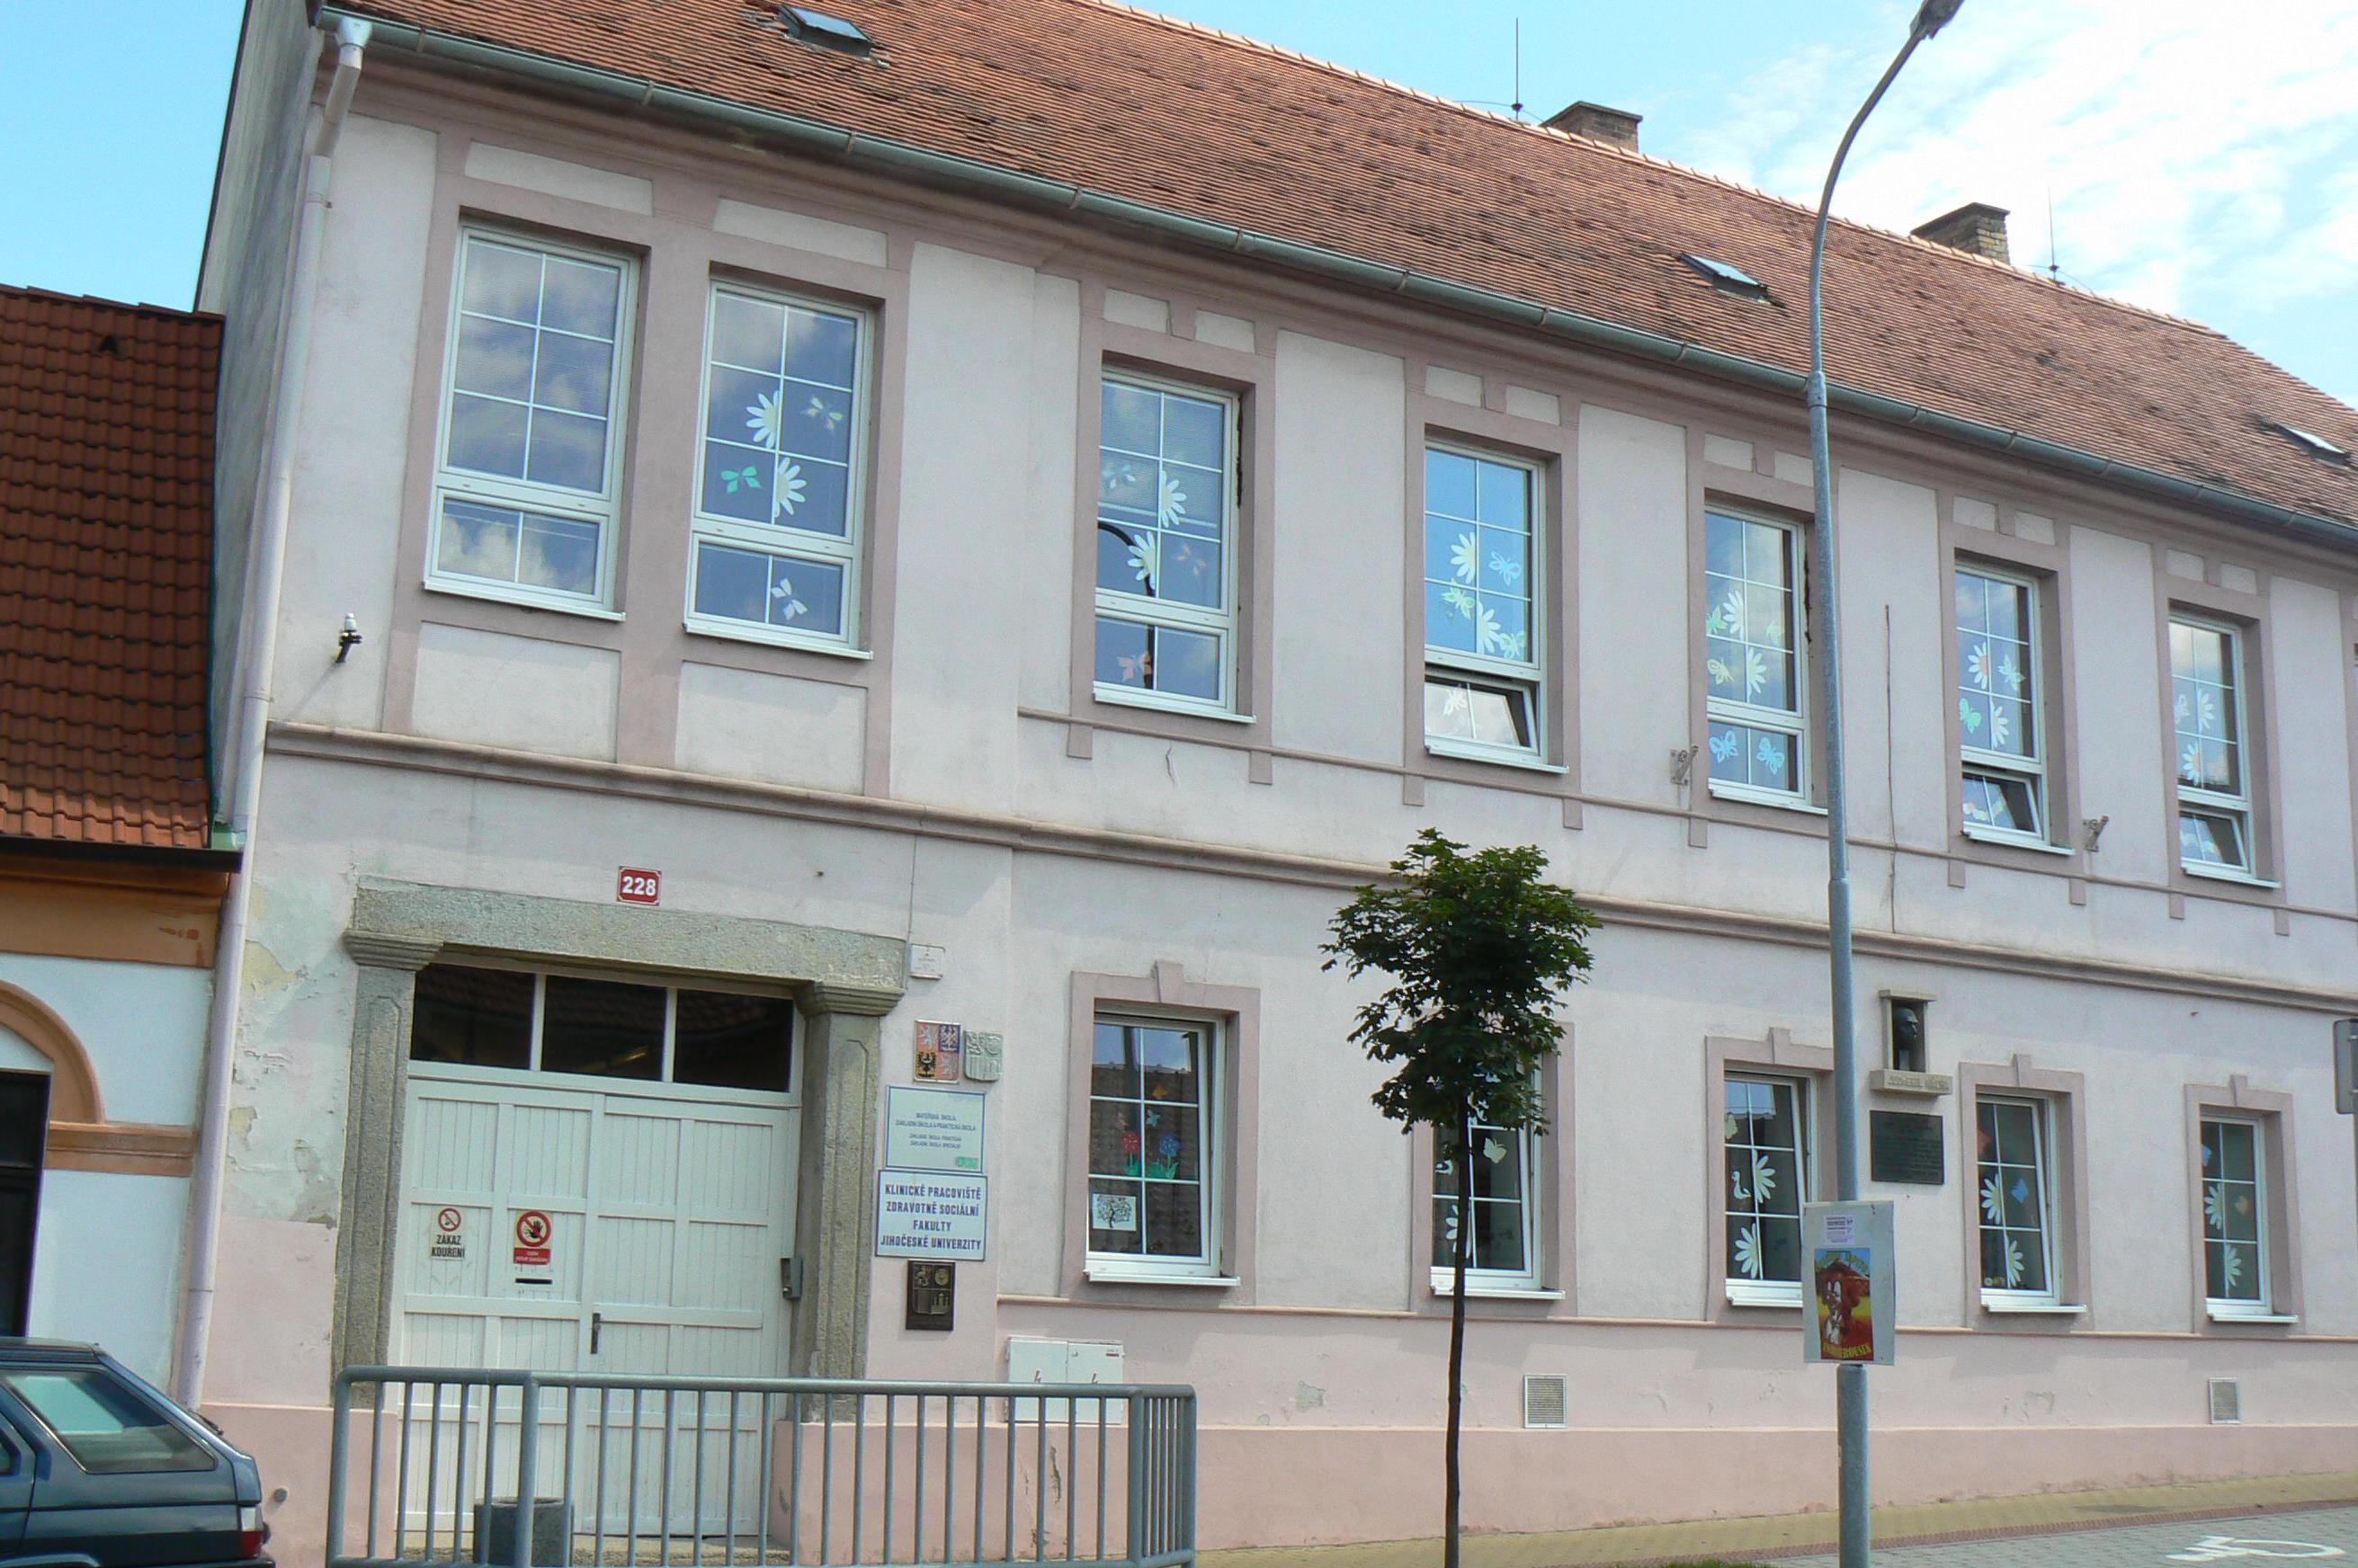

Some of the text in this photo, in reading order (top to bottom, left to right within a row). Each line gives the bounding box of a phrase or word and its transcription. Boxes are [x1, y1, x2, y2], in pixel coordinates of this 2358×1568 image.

[622, 876, 656, 896] 228
[885, 1184, 981, 1200] KLINICKÉ PRACOVIŠTĚ
[886, 1201, 979, 1216] ZDRAVOTNĚ SOCIÁLNÍ
[913, 1220, 951, 1232] FAKULTY
[880, 1234, 982, 1251] JIHOČESKÉ UNIVERZITY
